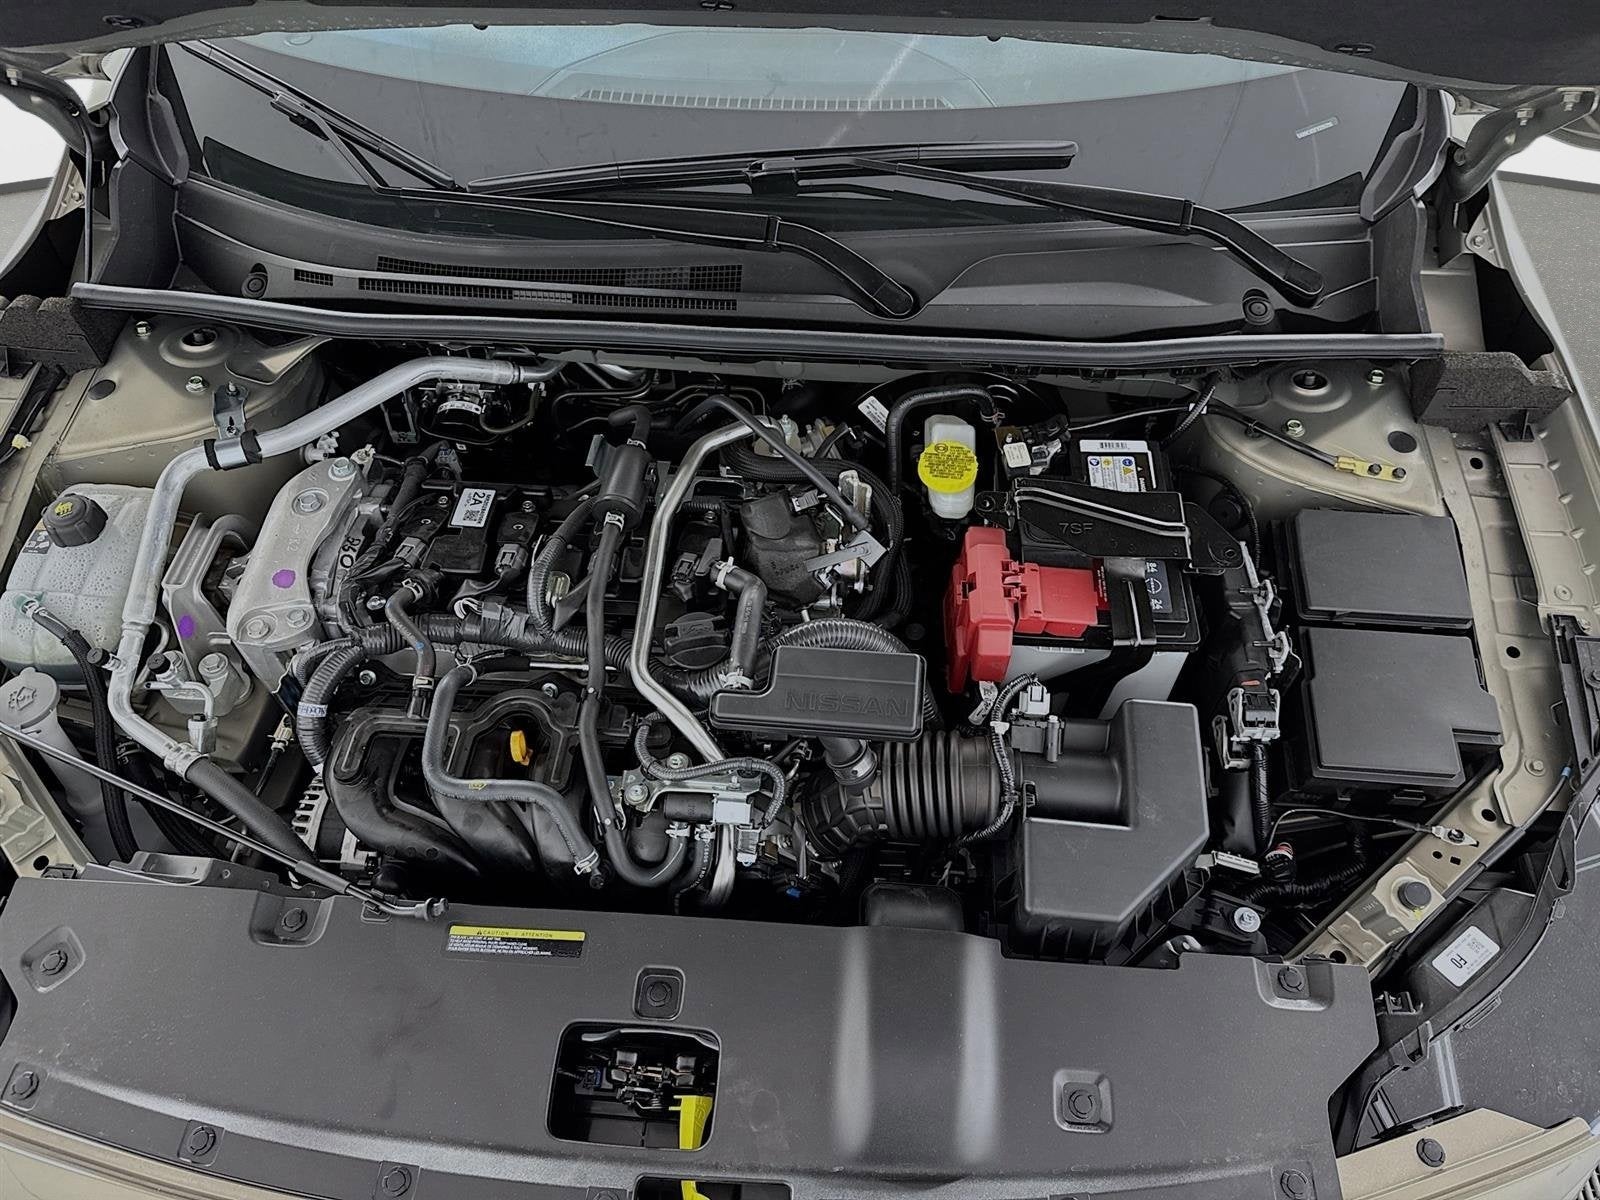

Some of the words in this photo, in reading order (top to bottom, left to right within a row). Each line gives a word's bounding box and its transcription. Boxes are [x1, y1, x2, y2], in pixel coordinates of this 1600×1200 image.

[469, 492, 486, 506] 2A
[1059, 522, 1093, 534] 7SF
[784, 688, 908, 718] NISSAN
